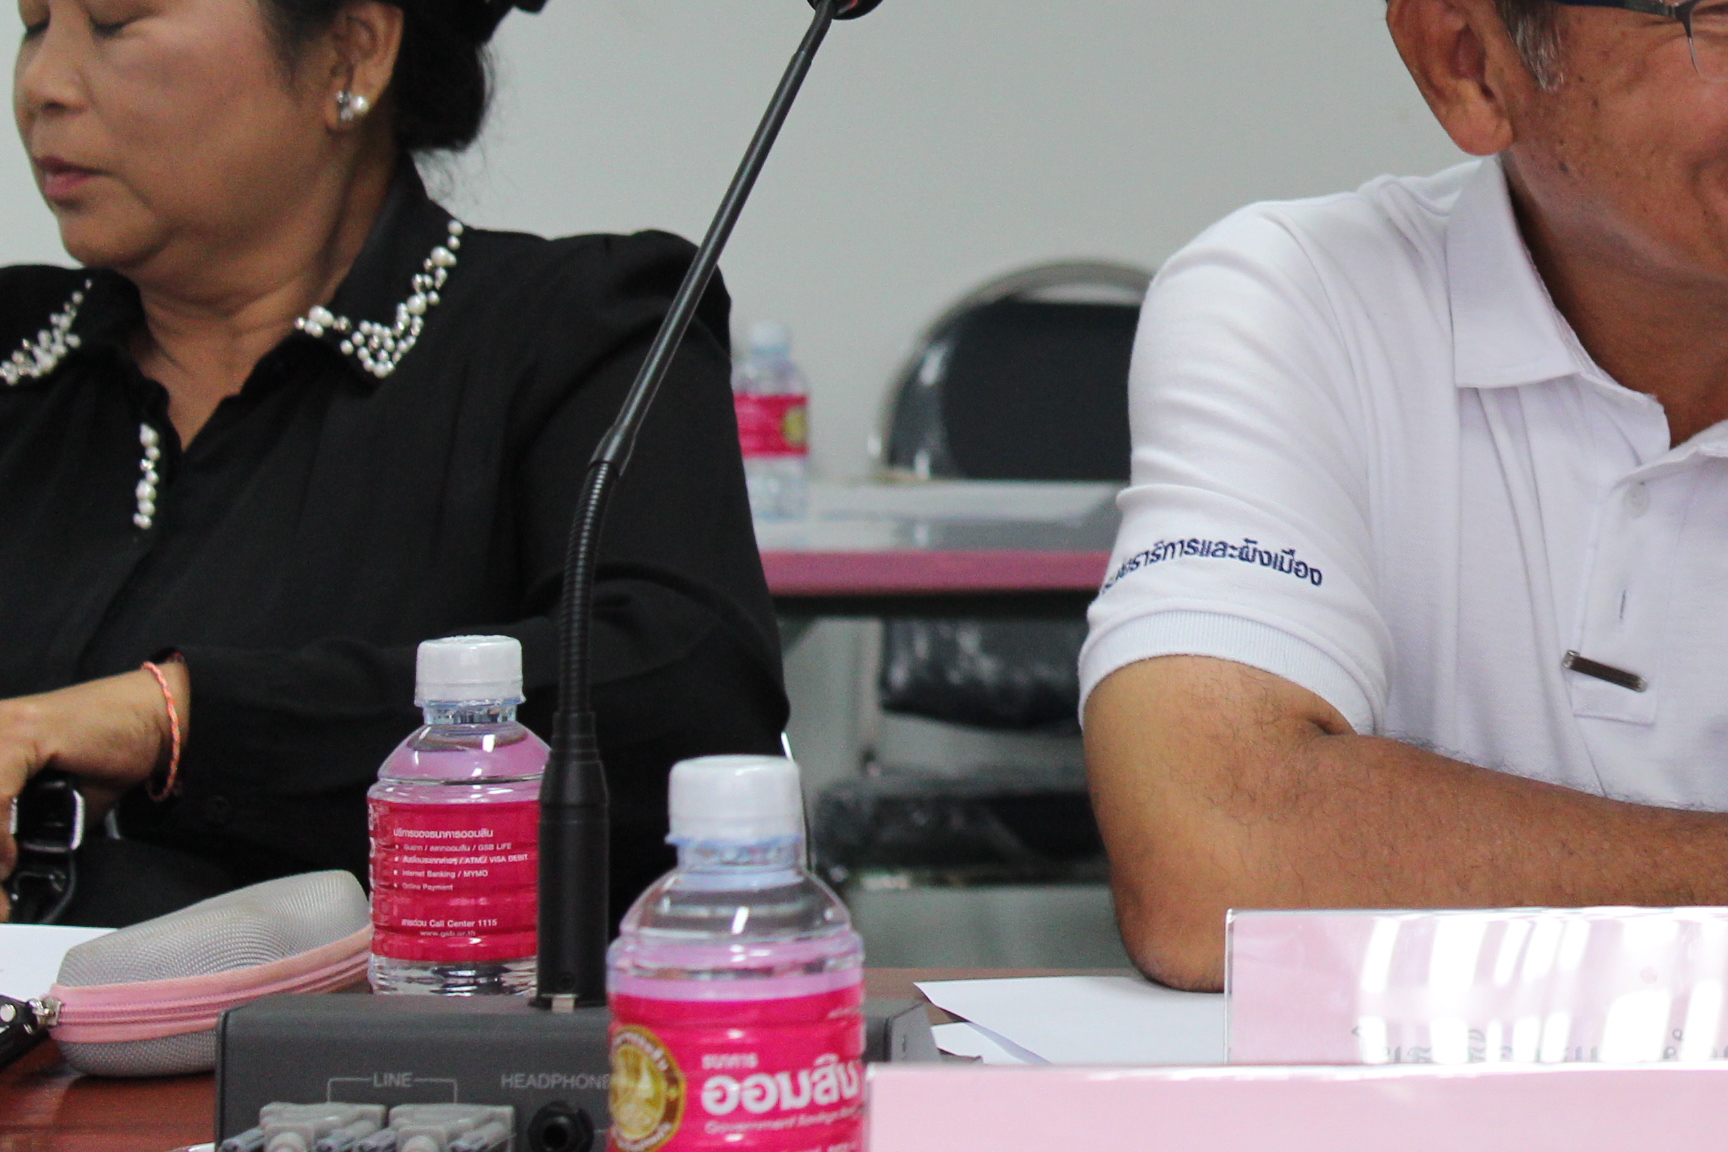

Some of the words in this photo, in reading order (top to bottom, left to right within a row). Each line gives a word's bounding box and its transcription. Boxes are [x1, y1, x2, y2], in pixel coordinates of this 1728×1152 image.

[427, 870, 456, 879] Banking
[463, 870, 489, 878] MYMO
[422, 883, 454, 893] Payment
[429, 919, 446, 927] Call
[447, 919, 476, 928] Center
[478, 919, 498, 927] 1115
[372, 1072, 414, 1088] LINE
